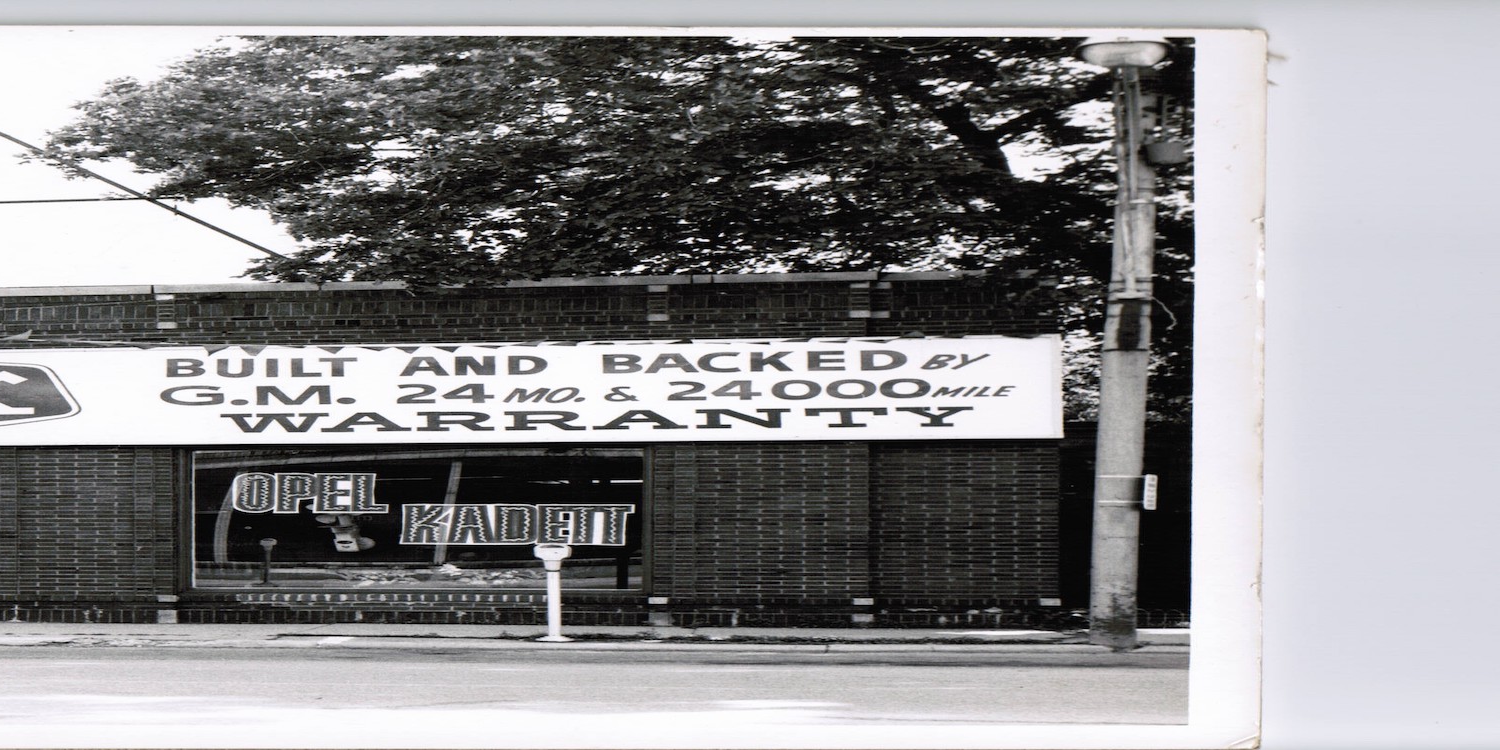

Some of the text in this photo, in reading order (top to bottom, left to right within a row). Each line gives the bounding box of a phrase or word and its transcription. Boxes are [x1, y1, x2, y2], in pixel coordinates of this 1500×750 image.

[165, 349, 991, 378] BUILT AND BACKED BY
[160, 378, 1017, 406] G.M. 24 MO. & 24000 MILE
[220, 405, 974, 433] WARRANTY
[232, 472, 389, 514] OPEL
[399, 503, 636, 545] KADETT
